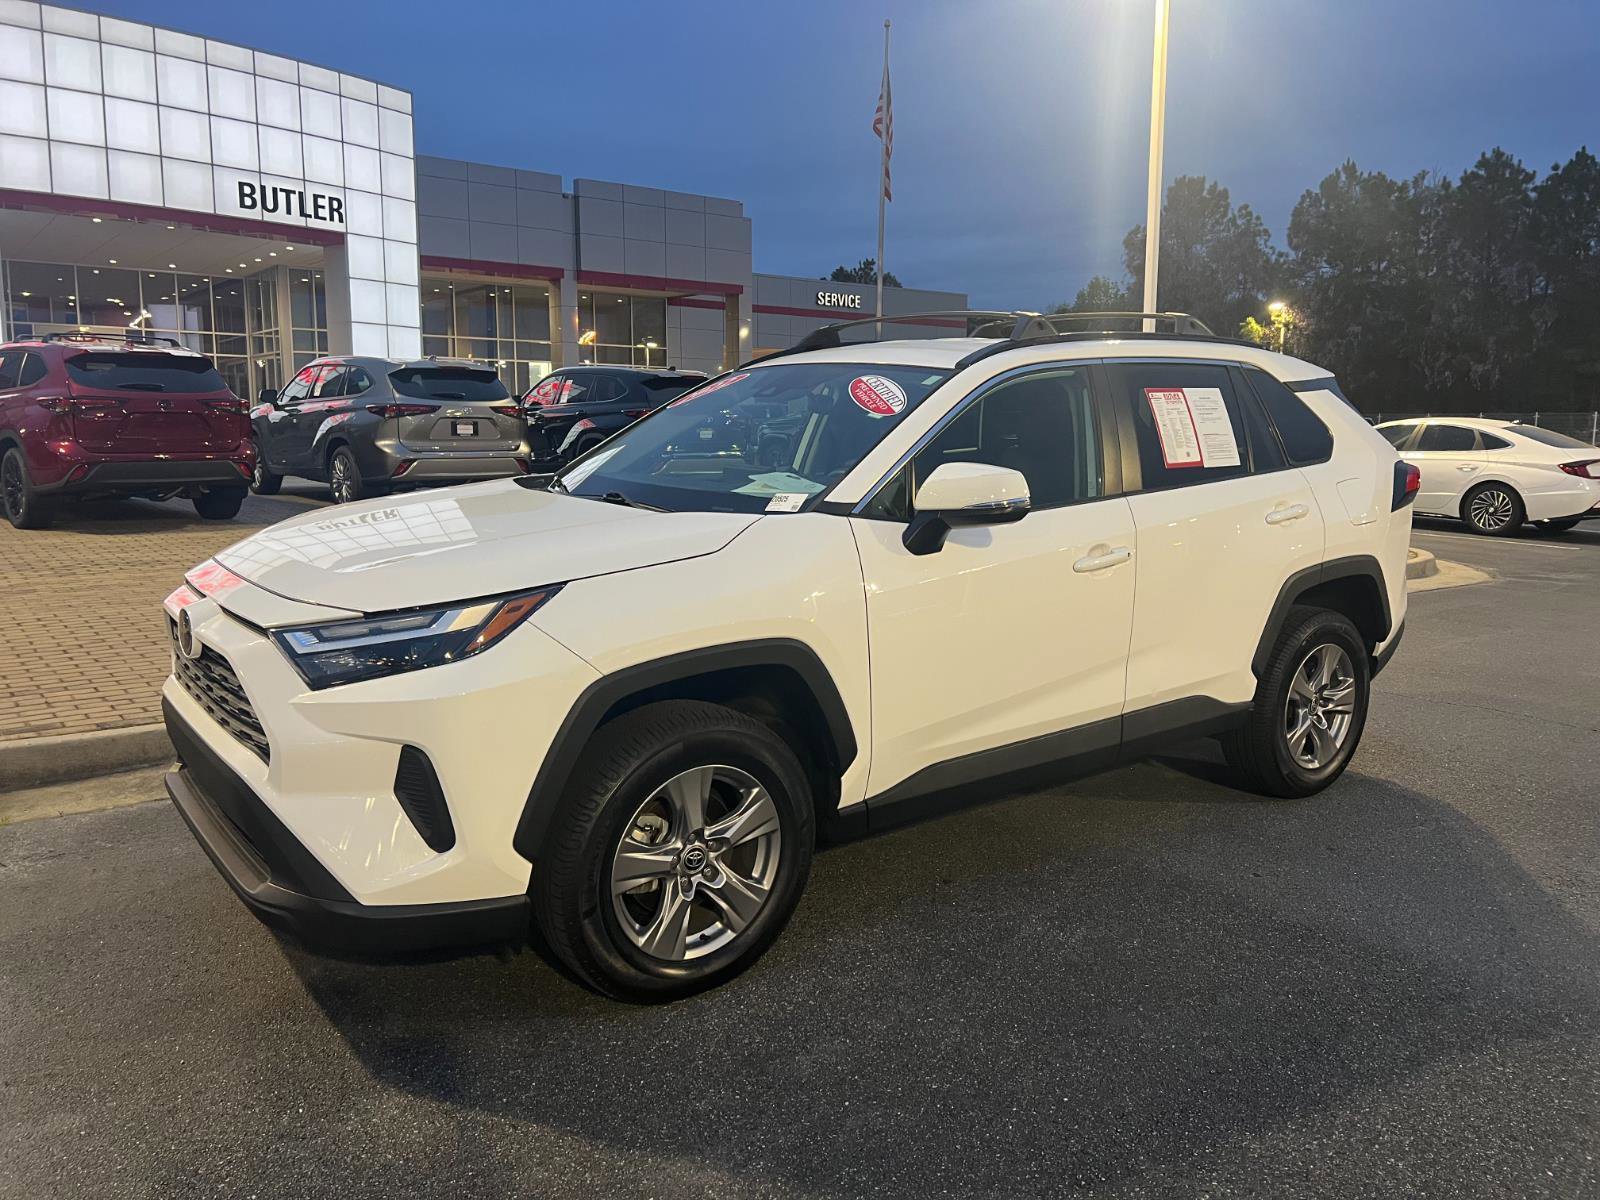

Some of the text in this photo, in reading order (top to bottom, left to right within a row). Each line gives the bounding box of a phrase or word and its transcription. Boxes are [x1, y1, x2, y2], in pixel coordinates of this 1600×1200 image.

[237, 181, 344, 224] BUTLER
[817, 291, 861, 309] SERVICE
[854, 388, 878, 410] VEHICLE
[857, 382, 888, 410] PRE-OWNED
[866, 377, 904, 407] CERTIFIED
